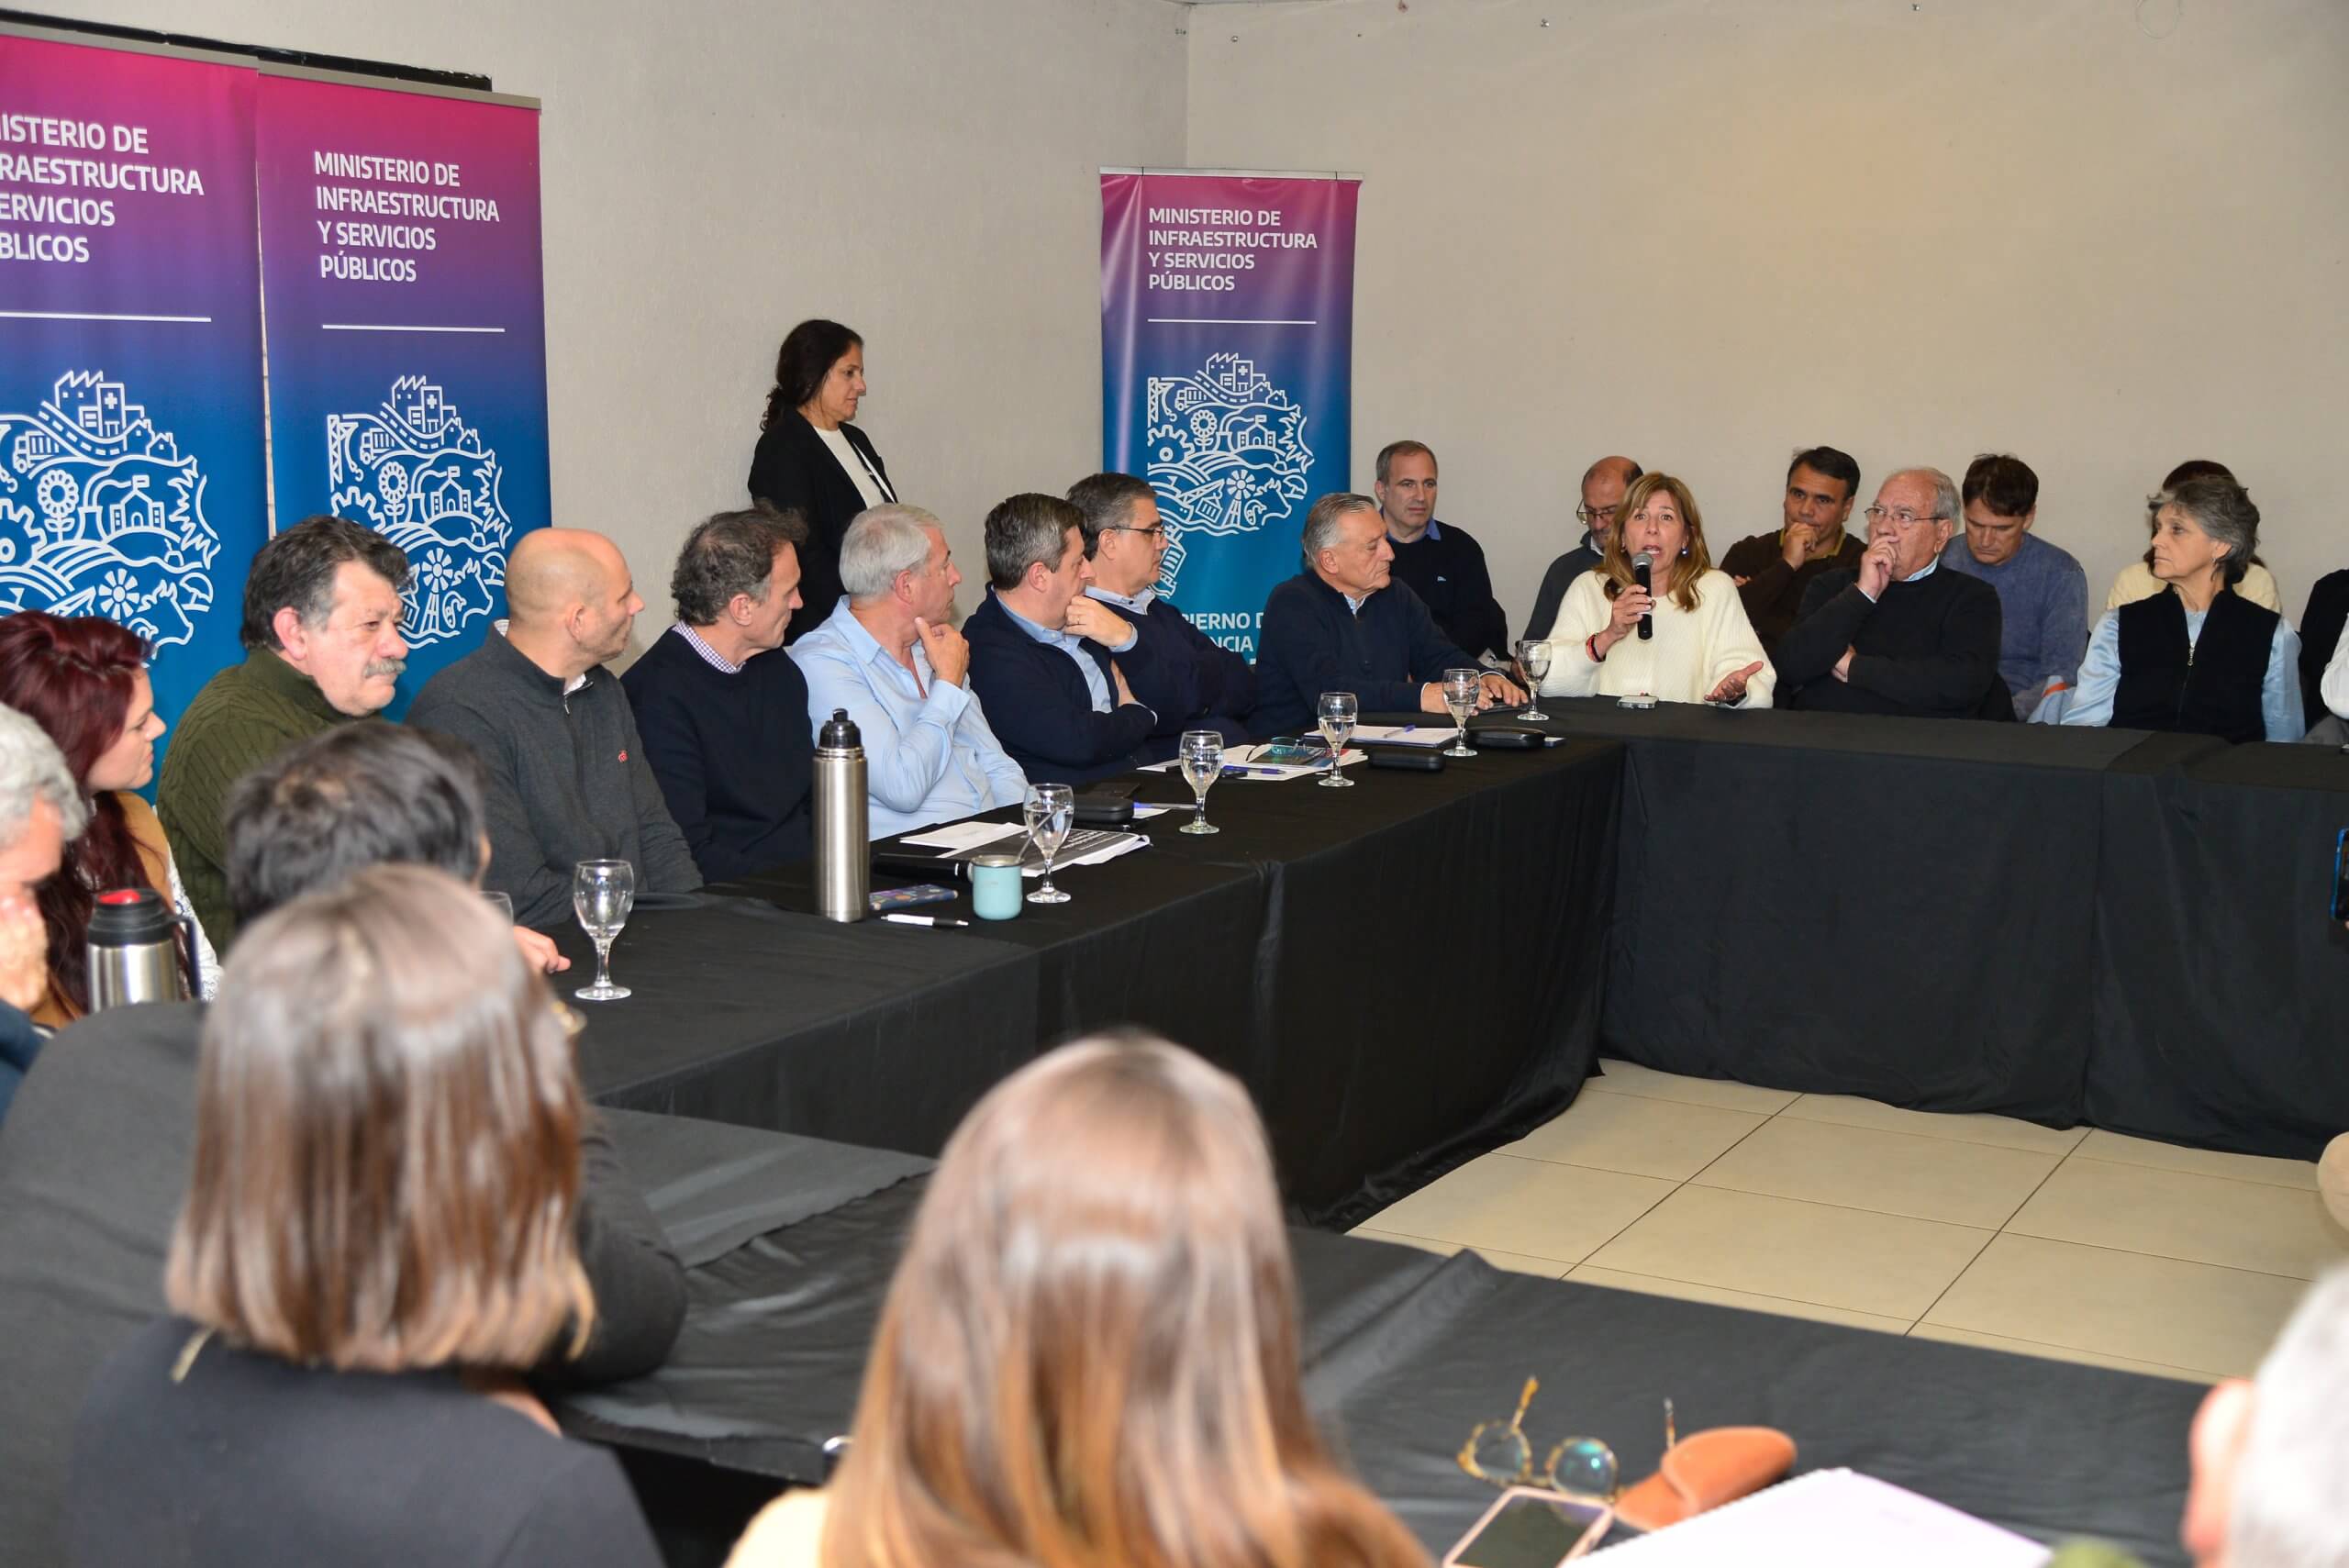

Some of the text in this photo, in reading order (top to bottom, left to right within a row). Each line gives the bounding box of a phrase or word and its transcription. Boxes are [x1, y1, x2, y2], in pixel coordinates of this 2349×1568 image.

[0, 113, 150, 154] ISTERIO DE
[0, 153, 205, 195] RAESTRUCTURA
[314, 150, 461, 187] MINISTERIO DE
[0, 193, 116, 227] ERVICIOS
[316, 186, 500, 222] INFRAESTRUCTURA
[1149, 207, 1281, 227] MINISTERIO DE
[0, 232, 90, 263] BLICOS
[317, 220, 437, 250] Y SERVICIOS
[1149, 229, 1318, 249] INFRAESTRUCTURA
[320, 250, 417, 283] PÚBLICOS
[1148, 251, 1255, 269] Y SERVICIOS
[1149, 271, 1235, 291] PÚBLICOS
[1182, 612, 1251, 630] IERNO
